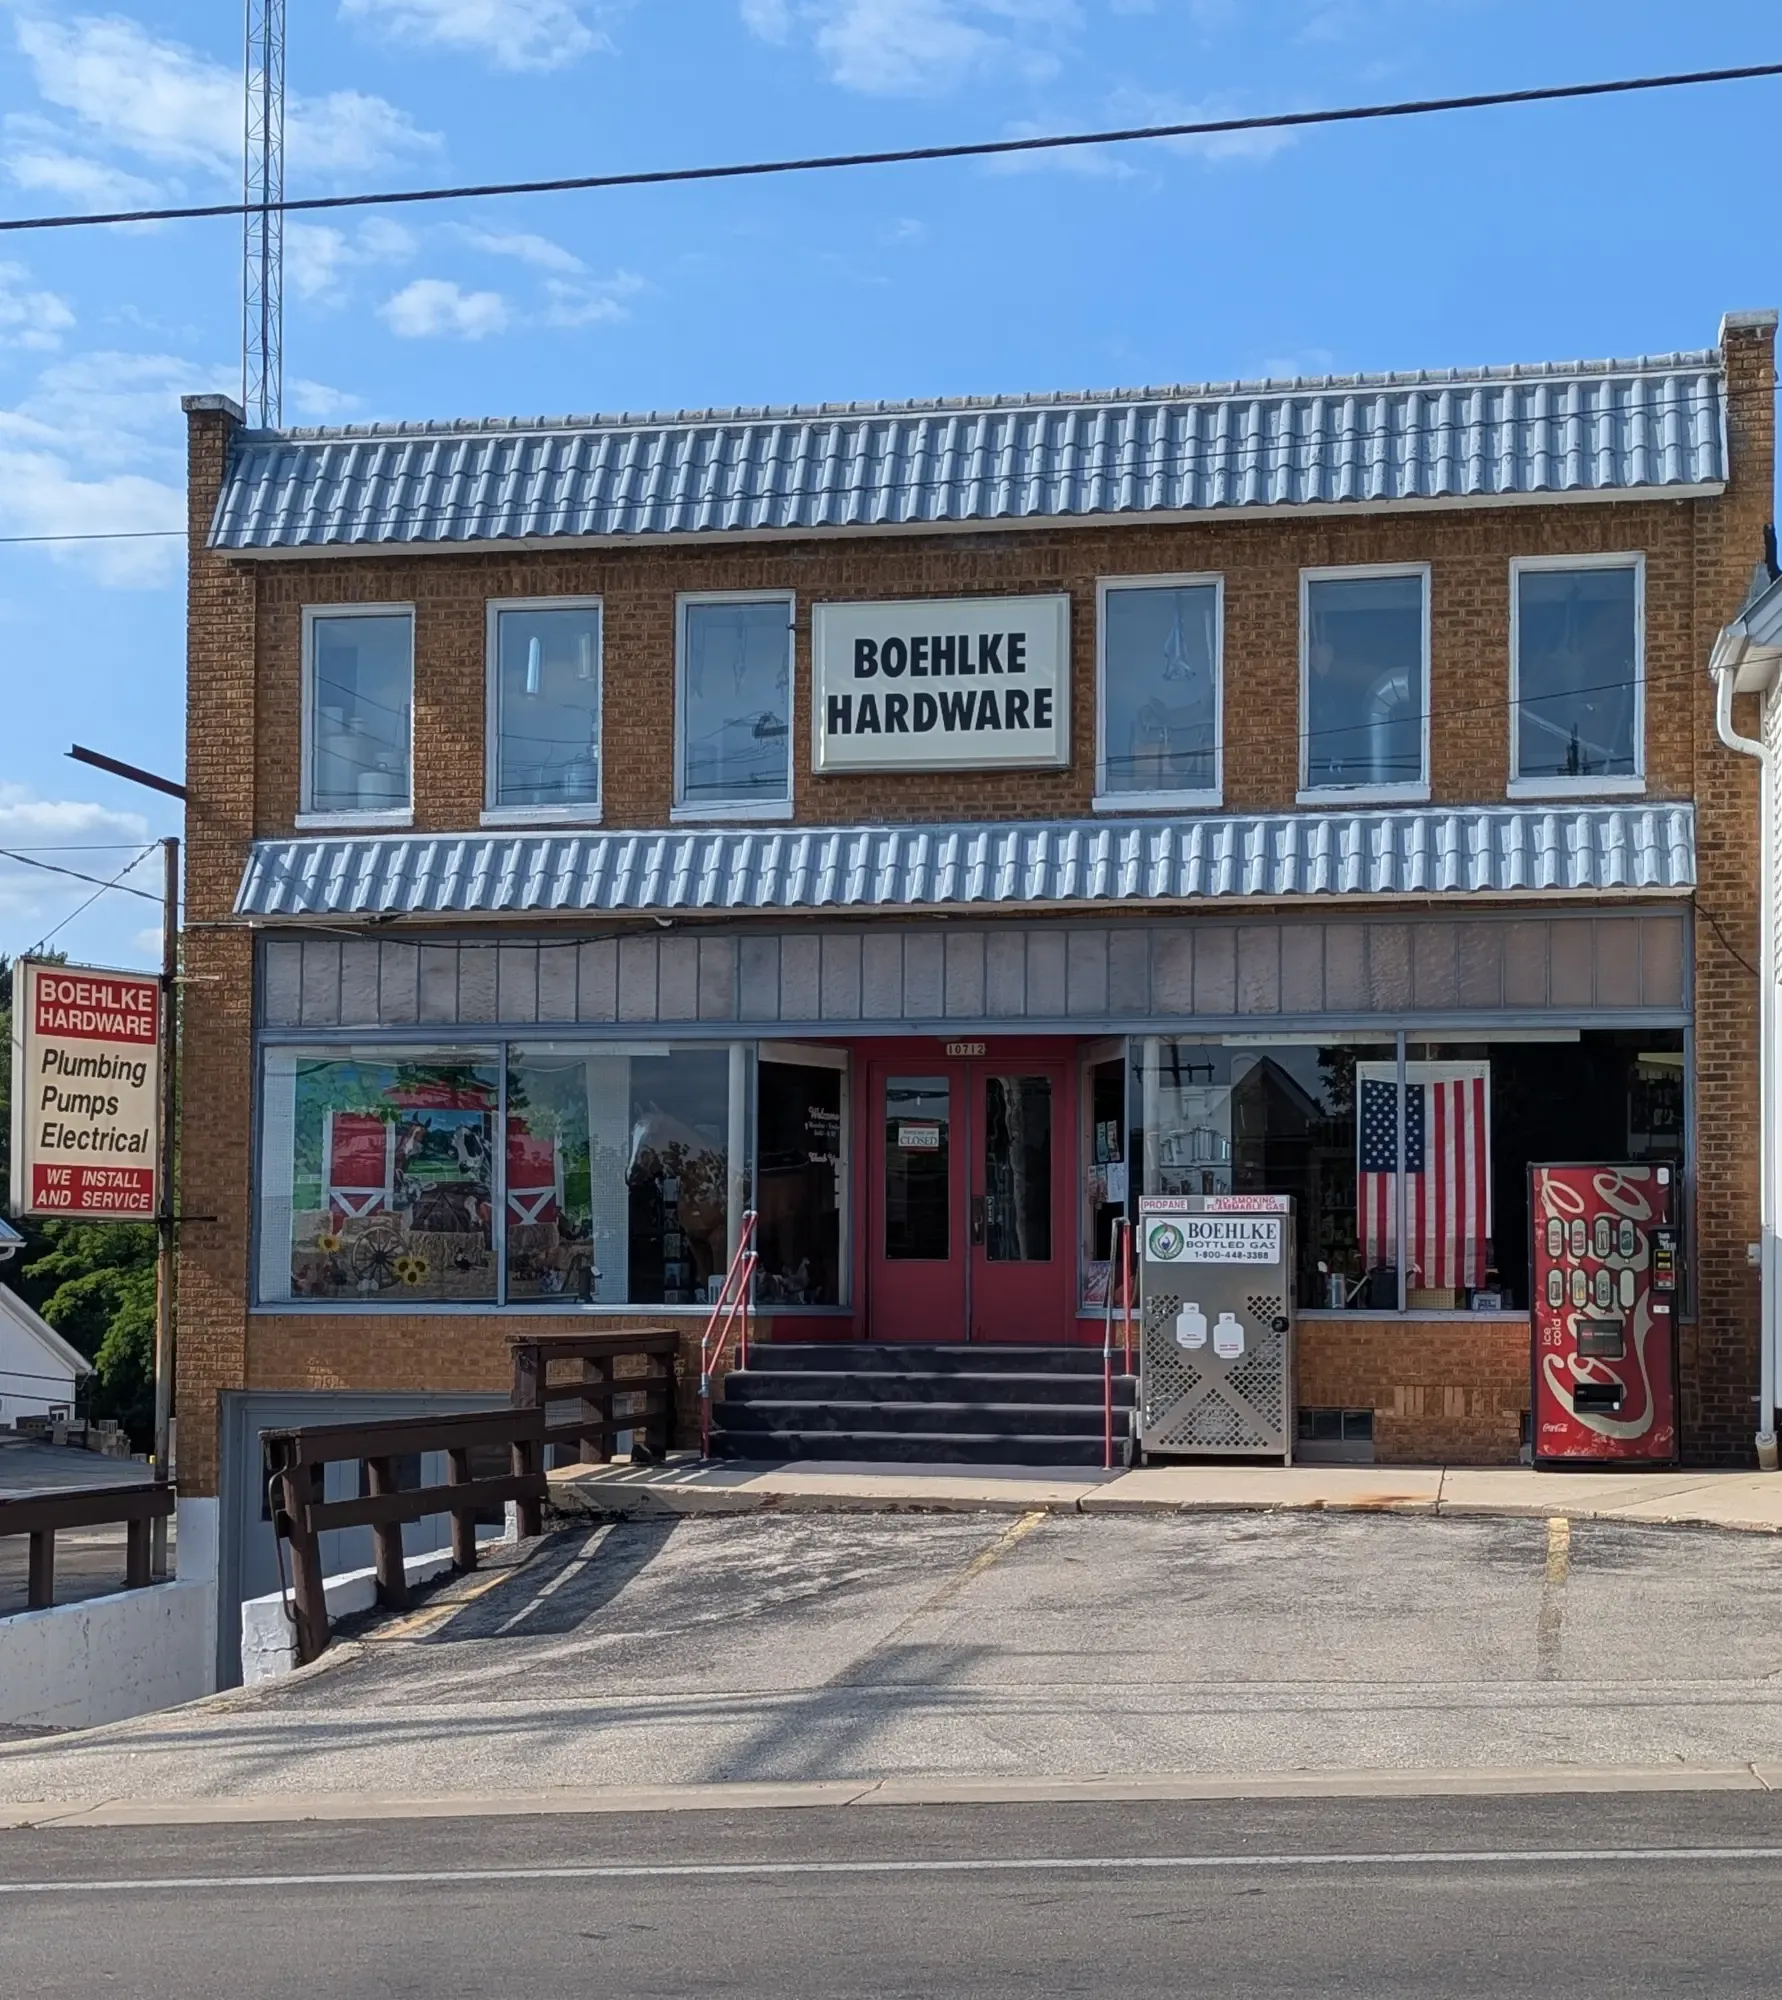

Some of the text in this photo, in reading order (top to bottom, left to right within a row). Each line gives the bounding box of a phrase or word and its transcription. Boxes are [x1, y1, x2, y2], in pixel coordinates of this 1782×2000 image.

[854, 632, 1026, 679] BOEHLKE
[827, 688, 1053, 735] HARDWARE
[40, 979, 153, 1012] BOEHLKE
[39, 1006, 152, 1037] HARDWARE
[949, 1044, 984, 1054] 10712
[41, 1048, 147, 1088] Plumbing
[41, 1085, 119, 1120] Pumps
[40, 1122, 149, 1154] Electrical
[900, 1135, 938, 1146] CLOSED
[46, 1168, 142, 1189] WE INSTALL
[36, 1189, 150, 1209] AND SERVICE
[1143, 1200, 1186, 1209] PROPANE
[1206, 1203, 1263, 1211] FLAMMABLE
[1232, 1196, 1276, 1204] SMOKING
[1188, 1222, 1277, 1240] BOEHLKE
[1186, 1240, 1275, 1249] BOTTLED GAS
[1551, 1318, 1562, 1346] cold
